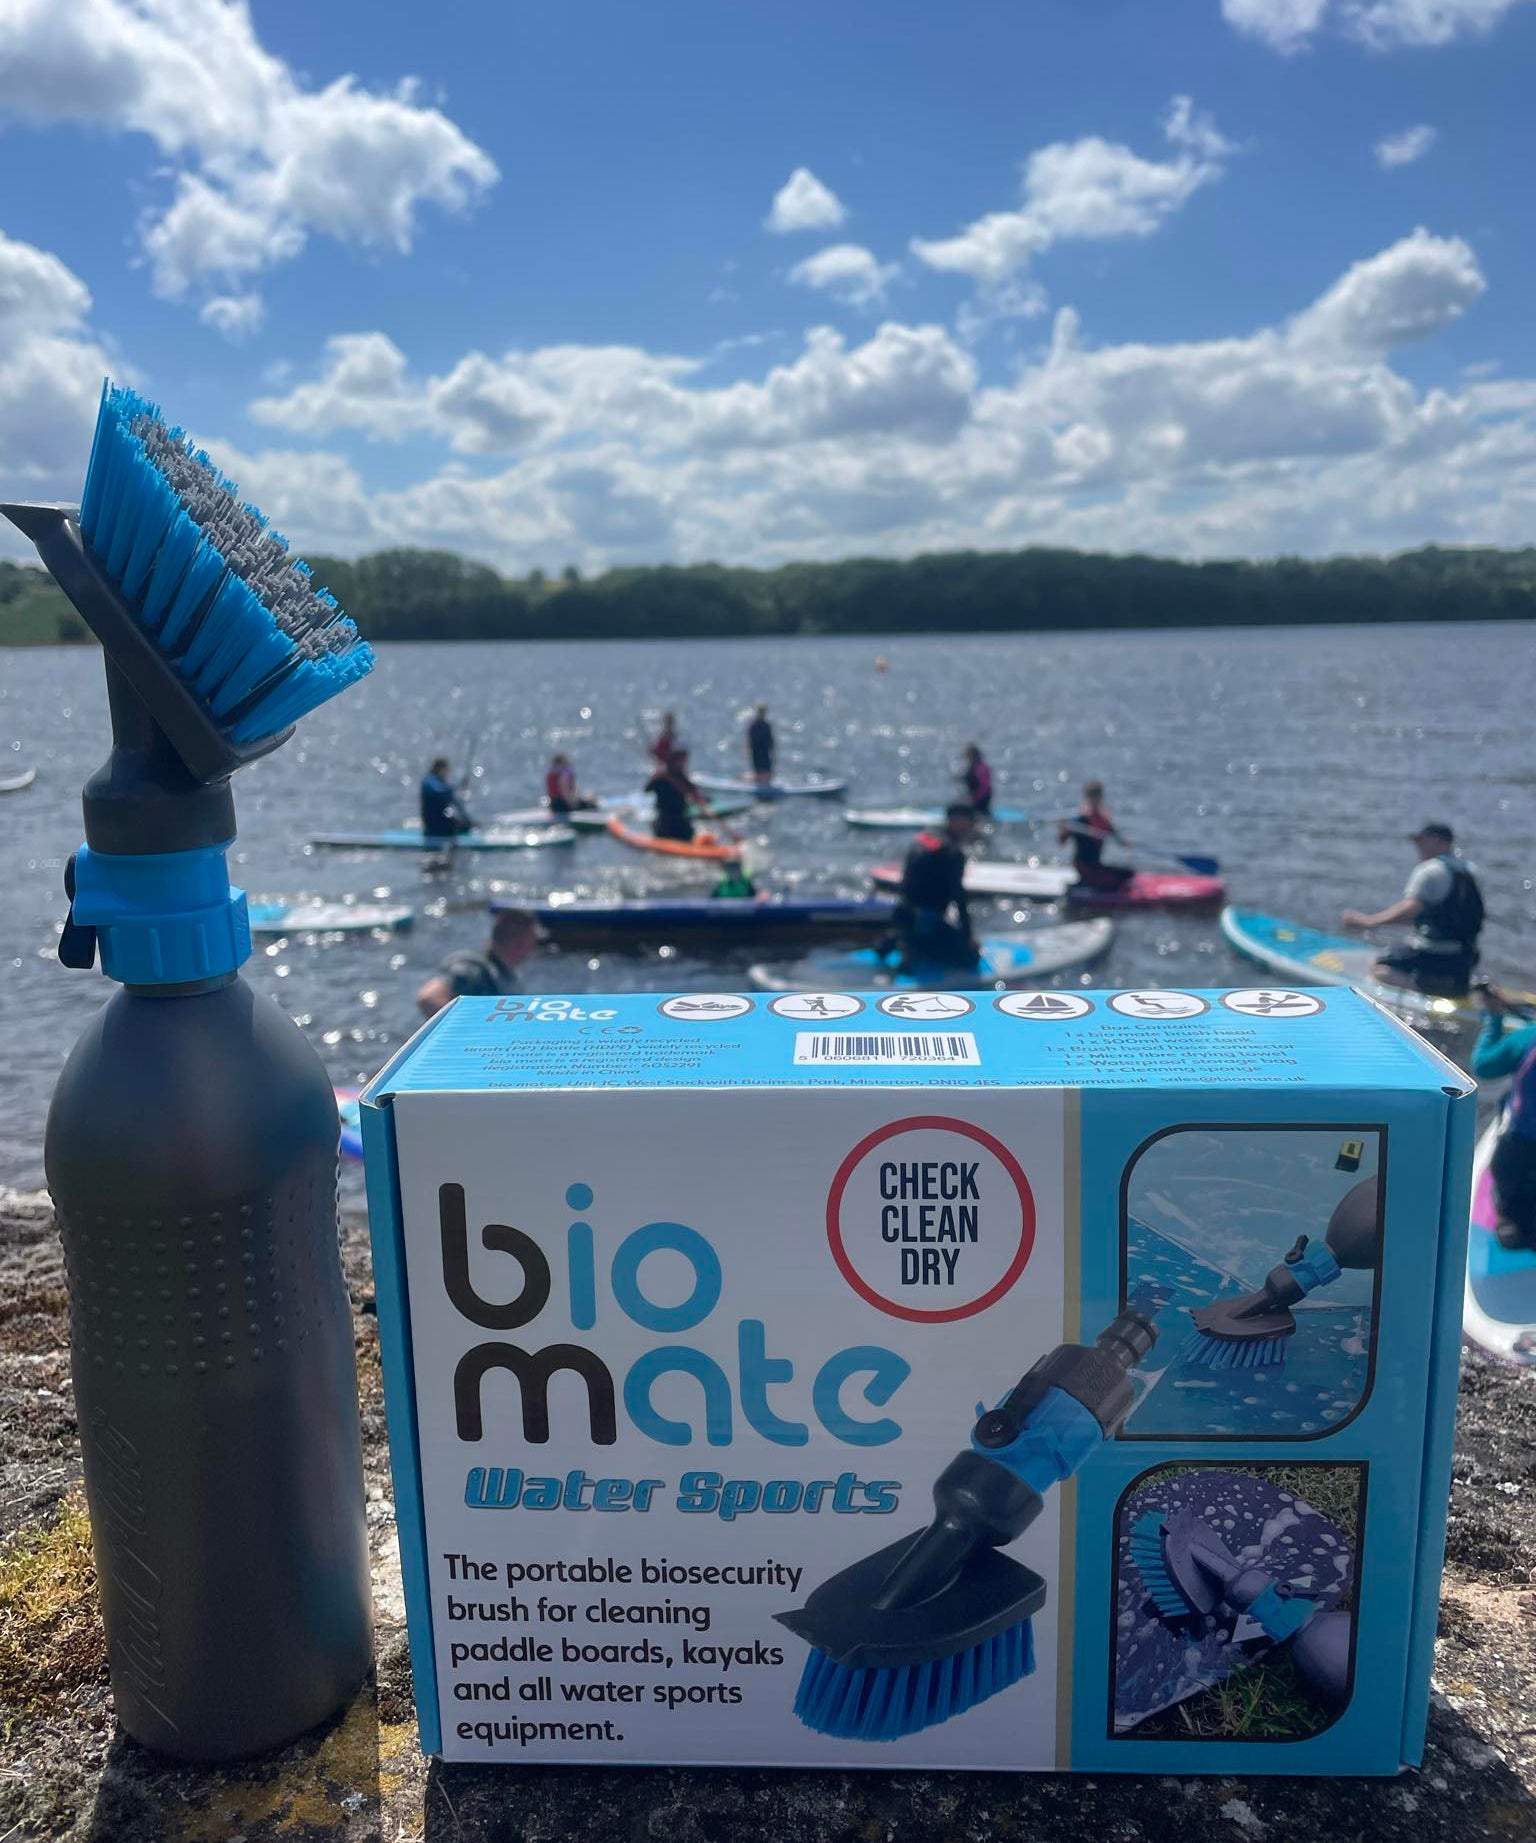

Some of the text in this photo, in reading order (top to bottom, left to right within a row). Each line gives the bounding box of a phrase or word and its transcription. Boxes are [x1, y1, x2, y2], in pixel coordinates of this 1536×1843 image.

[485, 1008, 619, 1022] mate
[494, 997, 572, 1012] bio
[510, 1038, 581, 1046] Packaging
[808, 1078, 845, 1086] Park,
[850, 1078, 924, 1086] Misterton,
[972, 1078, 1000, 1086] 4ES
[880, 1162, 980, 1200] CHECK
[882, 1205, 978, 1243] CLEAN
[438, 1182, 722, 1333] bio
[901, 1248, 960, 1285] DRY
[454, 1319, 912, 1447] mate
[464, 1466, 903, 1521] Water Sports
[444, 1554, 803, 1592] The portable biosecurity
[448, 1596, 711, 1632] brush for cleaning
[450, 1636, 784, 1671] paddle boards, kayaks
[454, 1676, 742, 1710] and all water sports
[456, 1716, 624, 1746] equipment.
